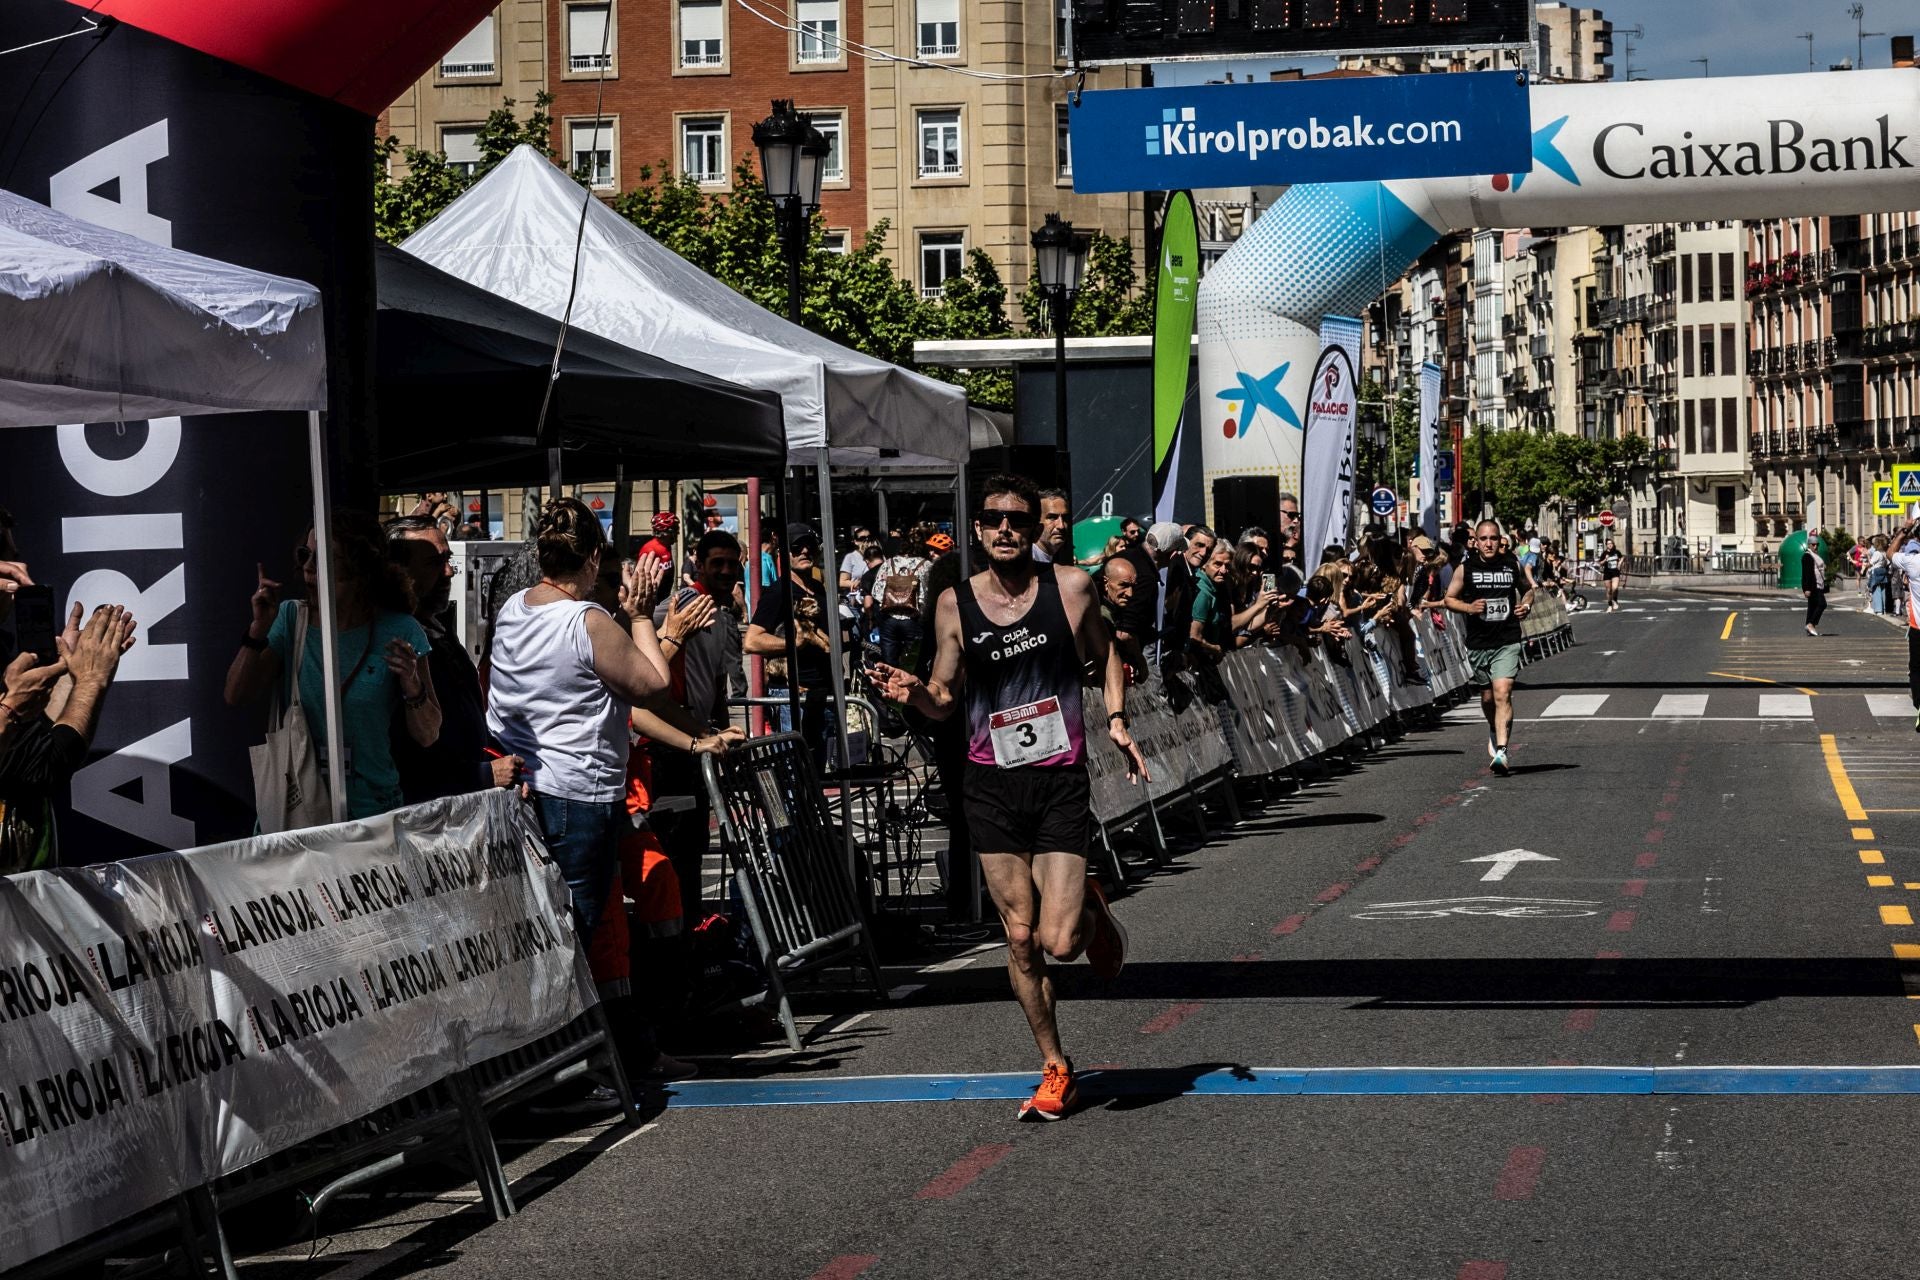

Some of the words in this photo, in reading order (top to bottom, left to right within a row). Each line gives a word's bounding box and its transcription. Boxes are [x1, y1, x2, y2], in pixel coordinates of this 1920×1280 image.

[1163, 113, 1462, 161] Kirolprobak.com
[1593, 114, 1914, 180] CaixaBank
[1488, 604, 1508, 615] 340
[990, 650, 1001, 661] O
[1003, 633, 1048, 658] BARCO
[1002, 627, 1029, 644] CUPA
[1015, 722, 1038, 747] 3
